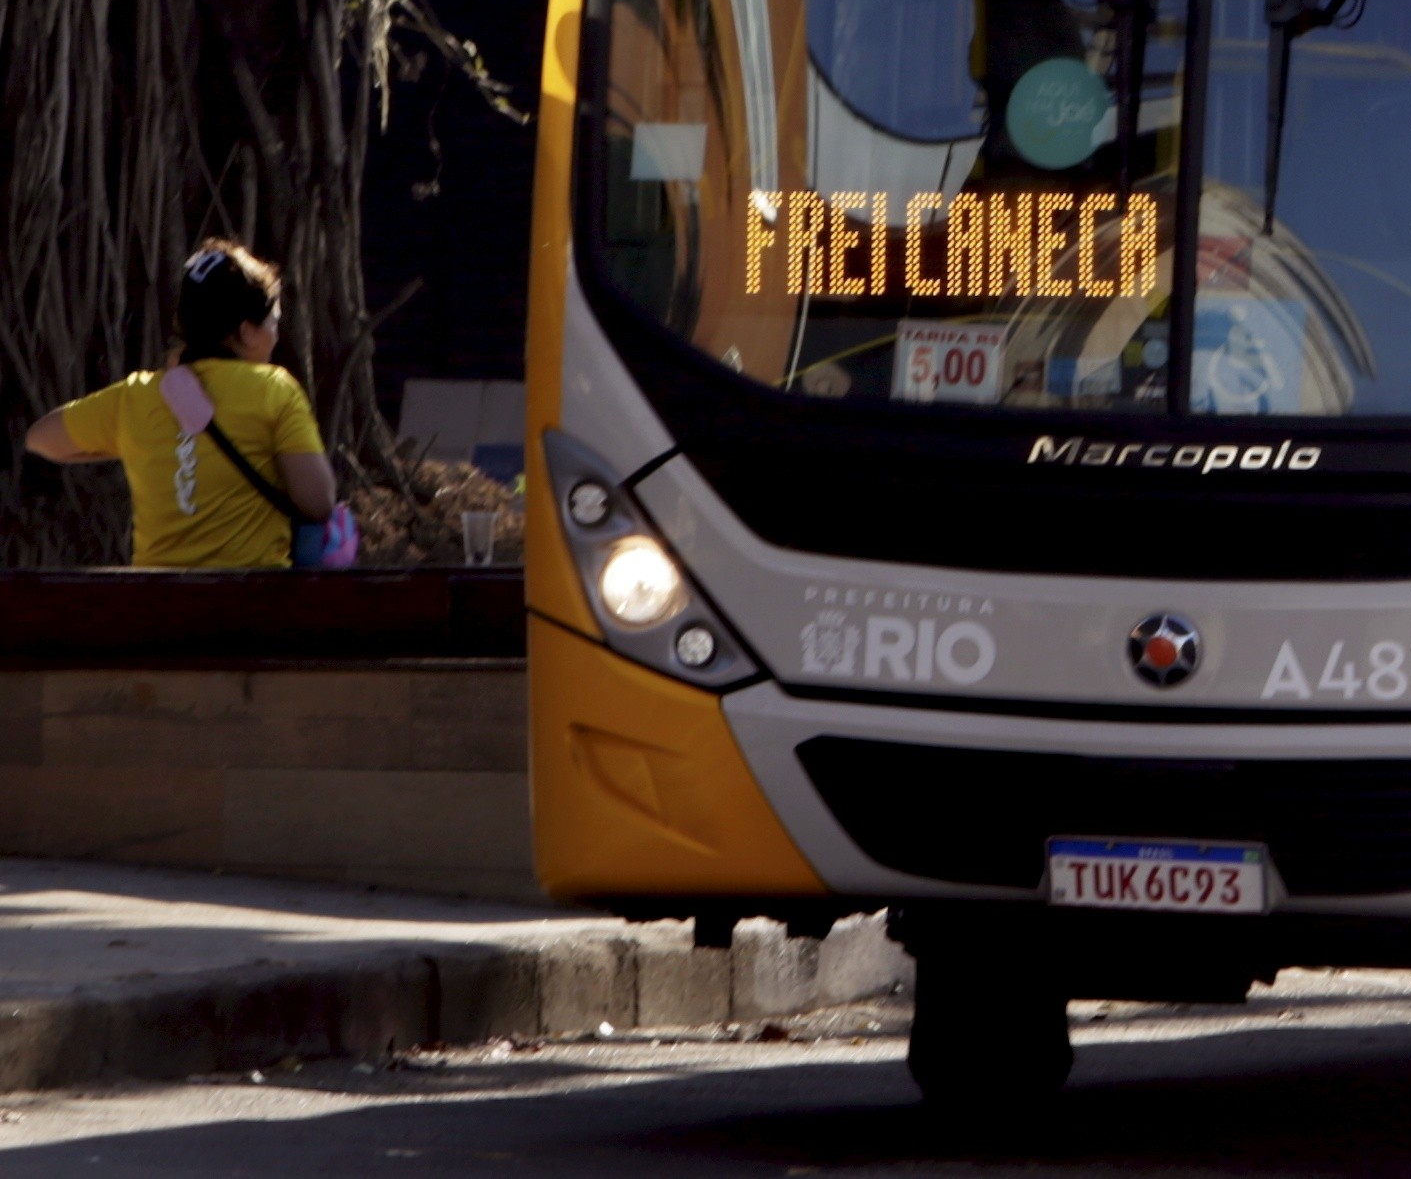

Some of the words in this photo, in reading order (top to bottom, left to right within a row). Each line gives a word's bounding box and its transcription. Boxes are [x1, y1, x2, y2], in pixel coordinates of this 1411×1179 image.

[746, 190, 888, 295] FREI
[904, 191, 1158, 298] CANECA
[910, 345, 987, 391] 5,00
[1026, 434, 1323, 475] Marcopolo
[804, 585, 995, 616] PREFEITURA
[862, 614, 996, 686] RIO
[1067, 860, 1242, 906] TUK6C93
